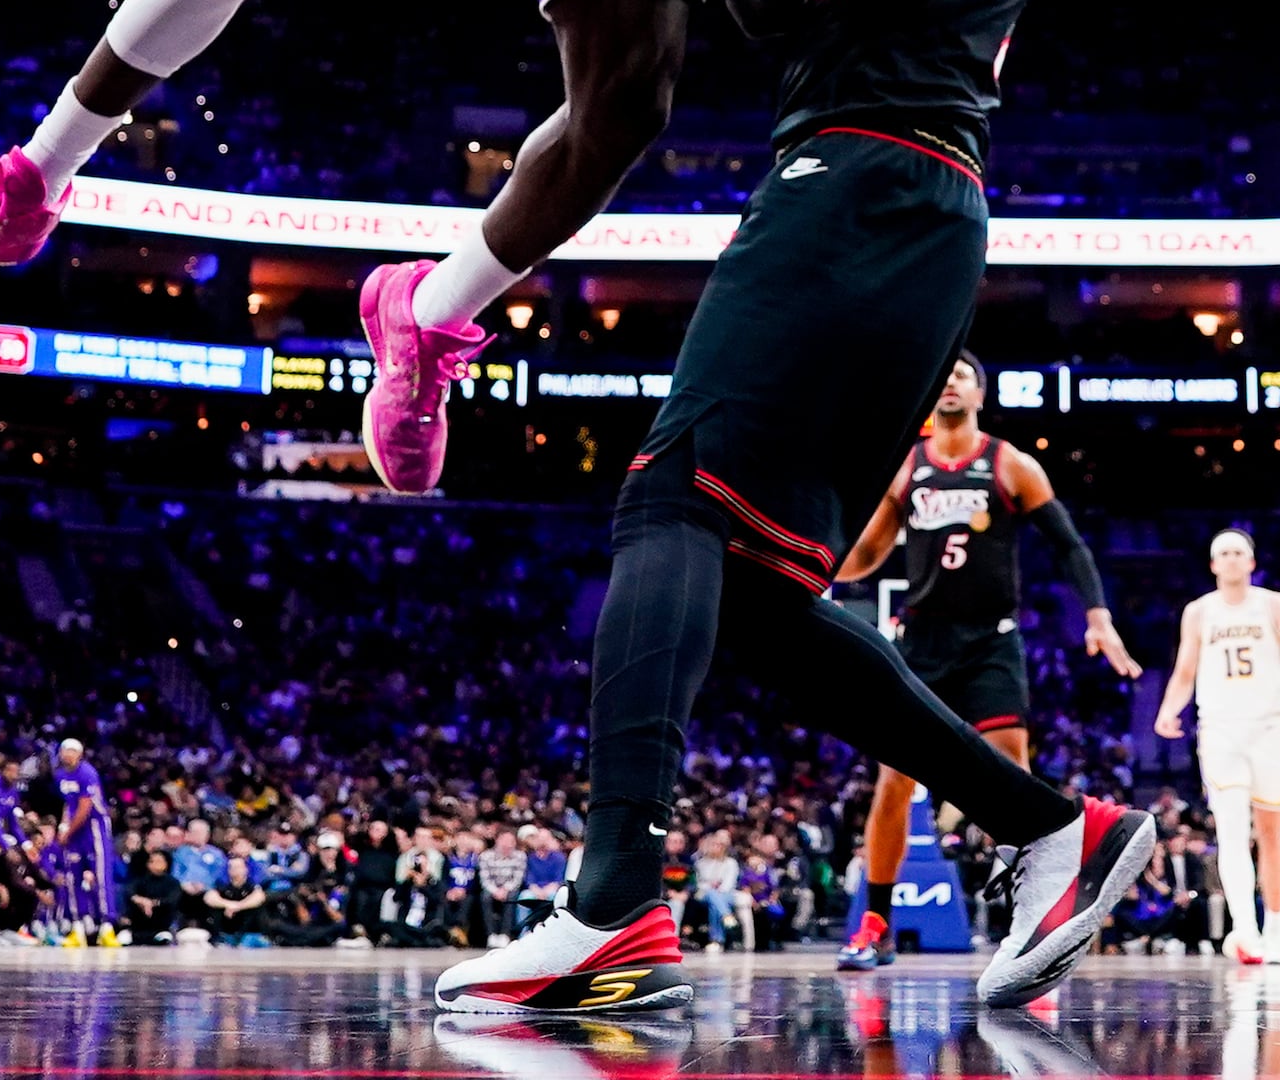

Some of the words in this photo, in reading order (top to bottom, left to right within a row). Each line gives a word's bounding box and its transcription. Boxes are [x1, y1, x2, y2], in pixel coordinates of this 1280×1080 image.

[141, 198, 232, 224] AND
[247, 209, 439, 239] ANDREW
[1073, 232, 1121, 252] TO
[940, 532, 970, 571] 5
[1223, 645, 1254, 680] 15
